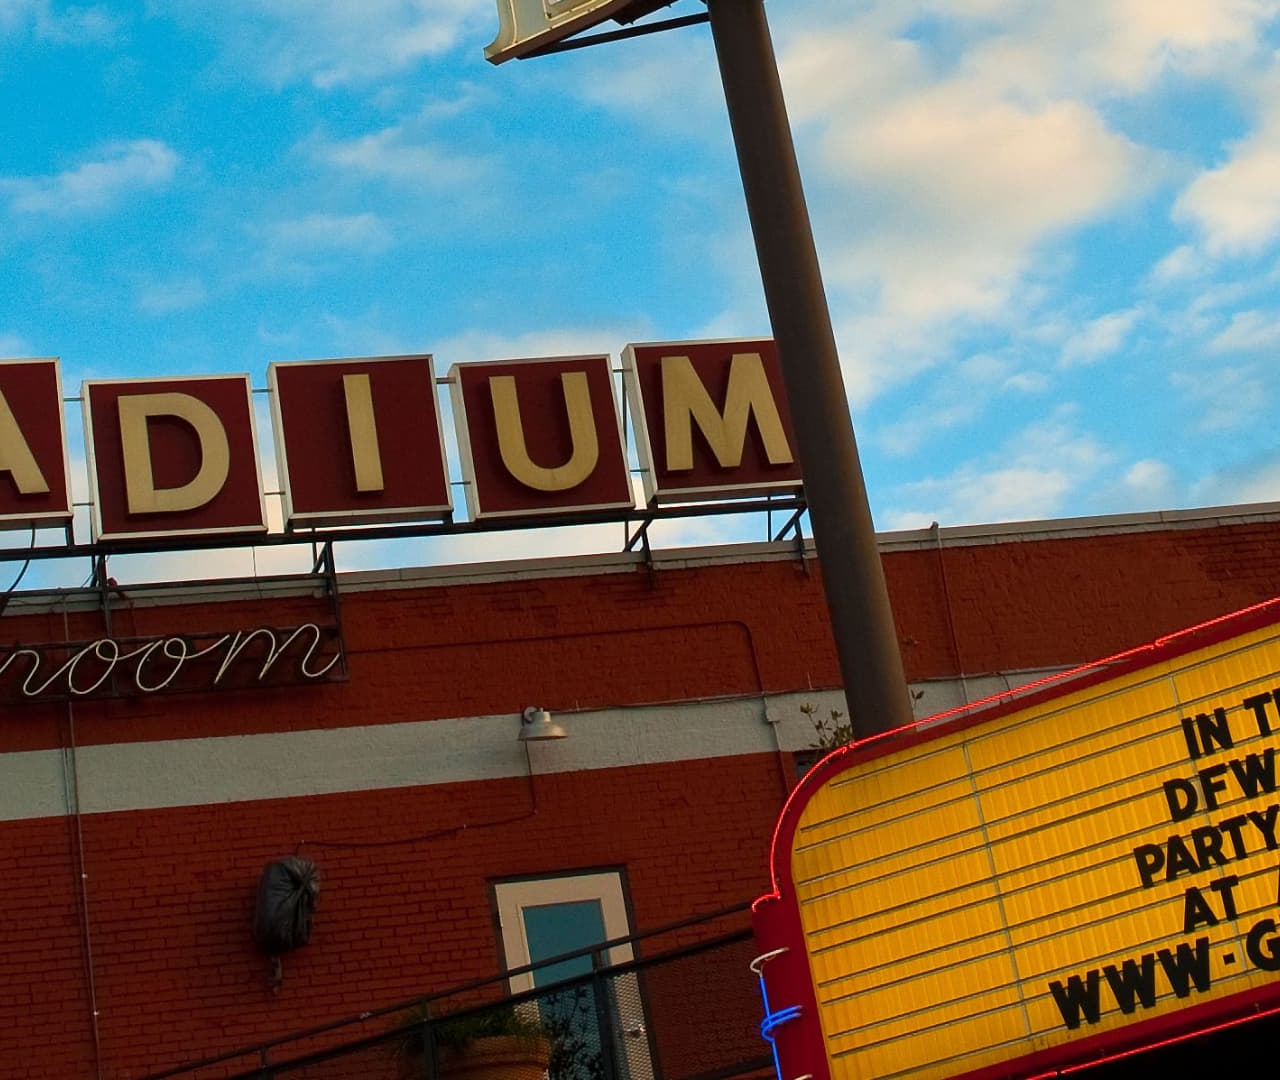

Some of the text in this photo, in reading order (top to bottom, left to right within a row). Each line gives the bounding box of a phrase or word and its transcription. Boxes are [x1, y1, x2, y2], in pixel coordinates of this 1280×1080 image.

[1181, 707, 1235, 761] IN
[1163, 747, 1278, 823] DFW
[1133, 804, 1280, 890] PARTY
[1183, 875, 1240, 935] AT
